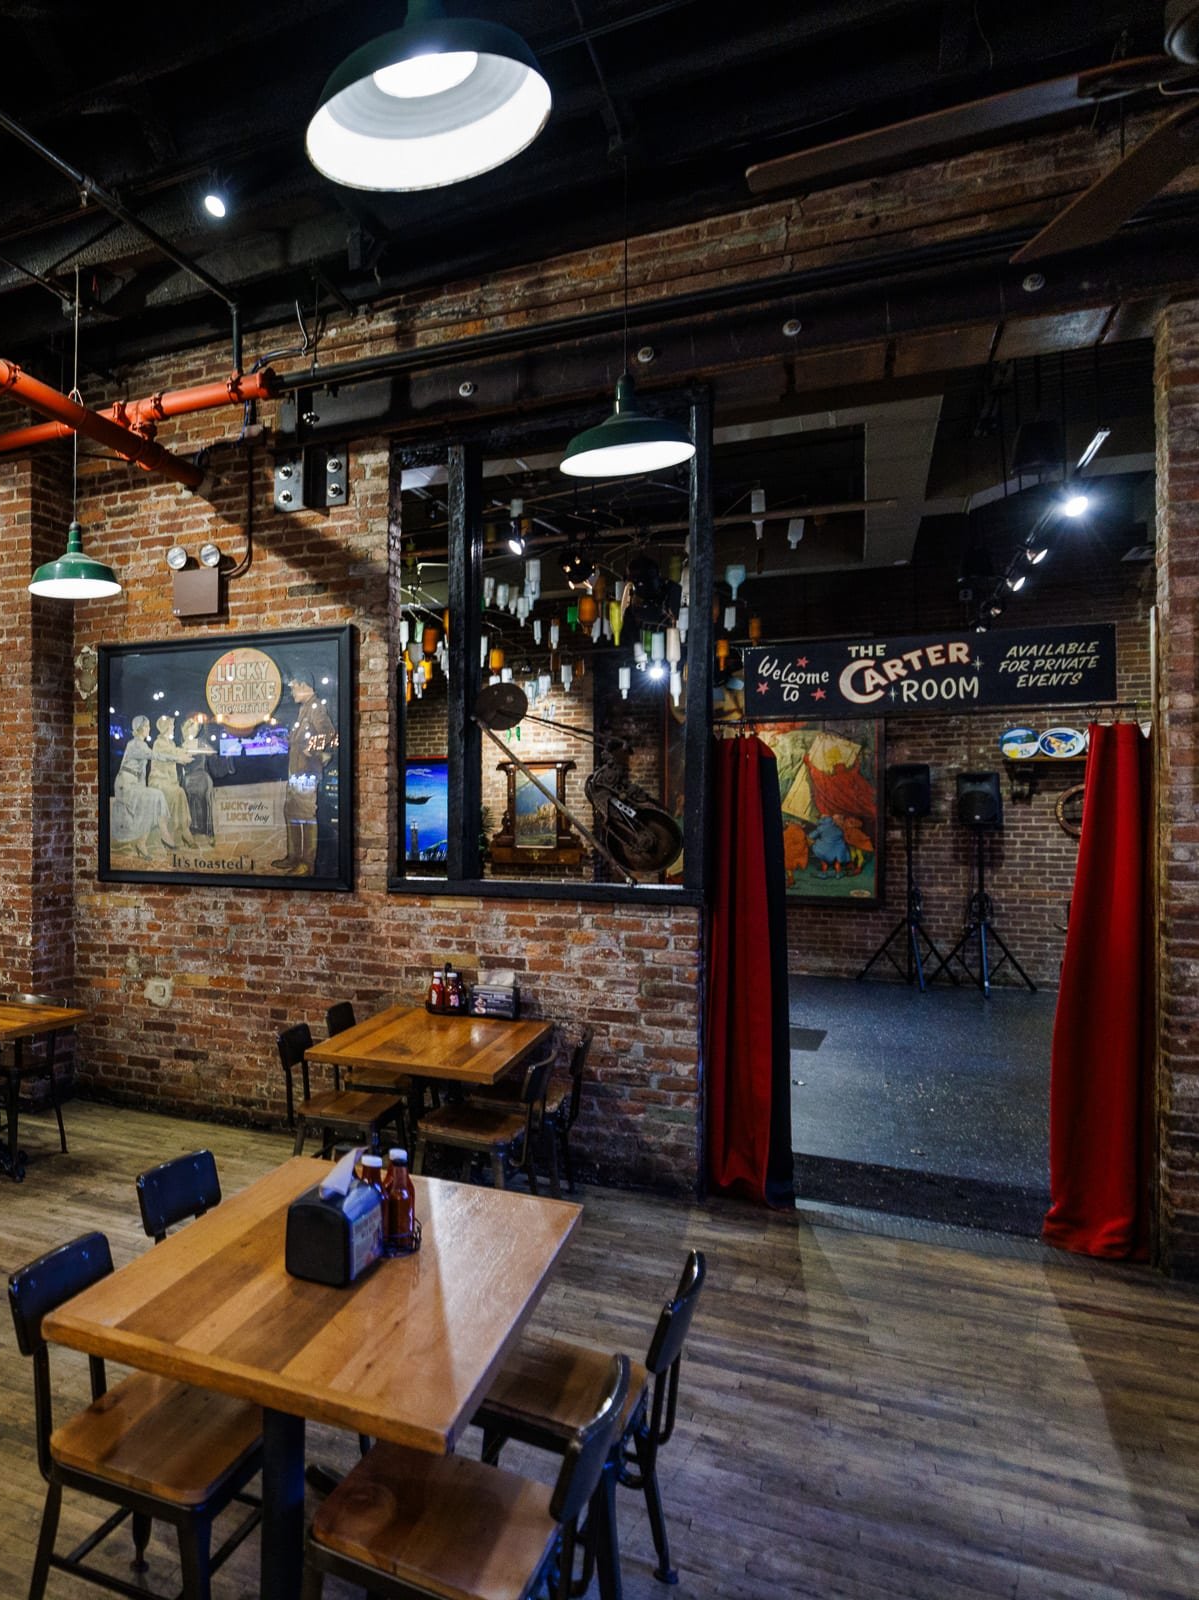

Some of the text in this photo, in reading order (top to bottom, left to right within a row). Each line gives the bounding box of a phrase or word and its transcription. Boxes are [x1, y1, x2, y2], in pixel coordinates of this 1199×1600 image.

[848, 644, 887, 658] THE
[1006, 641, 1099, 658] AVAILABLE
[216, 661, 269, 682] LUCKY
[758, 656, 830, 685] Welcome
[999, 655, 1100, 673] FOR PRIVATE
[838, 642, 971, 705] CARTER
[1016, 672, 1083, 688] EVENTS
[211, 681, 275, 702] STRIKE
[780, 684, 800, 702] To
[901, 676, 980, 702] ROOM
[216, 702, 270, 714] CIGARETTE
[220, 801, 248, 811] LUCKY
[226, 812, 270, 824] LUCKY boy
